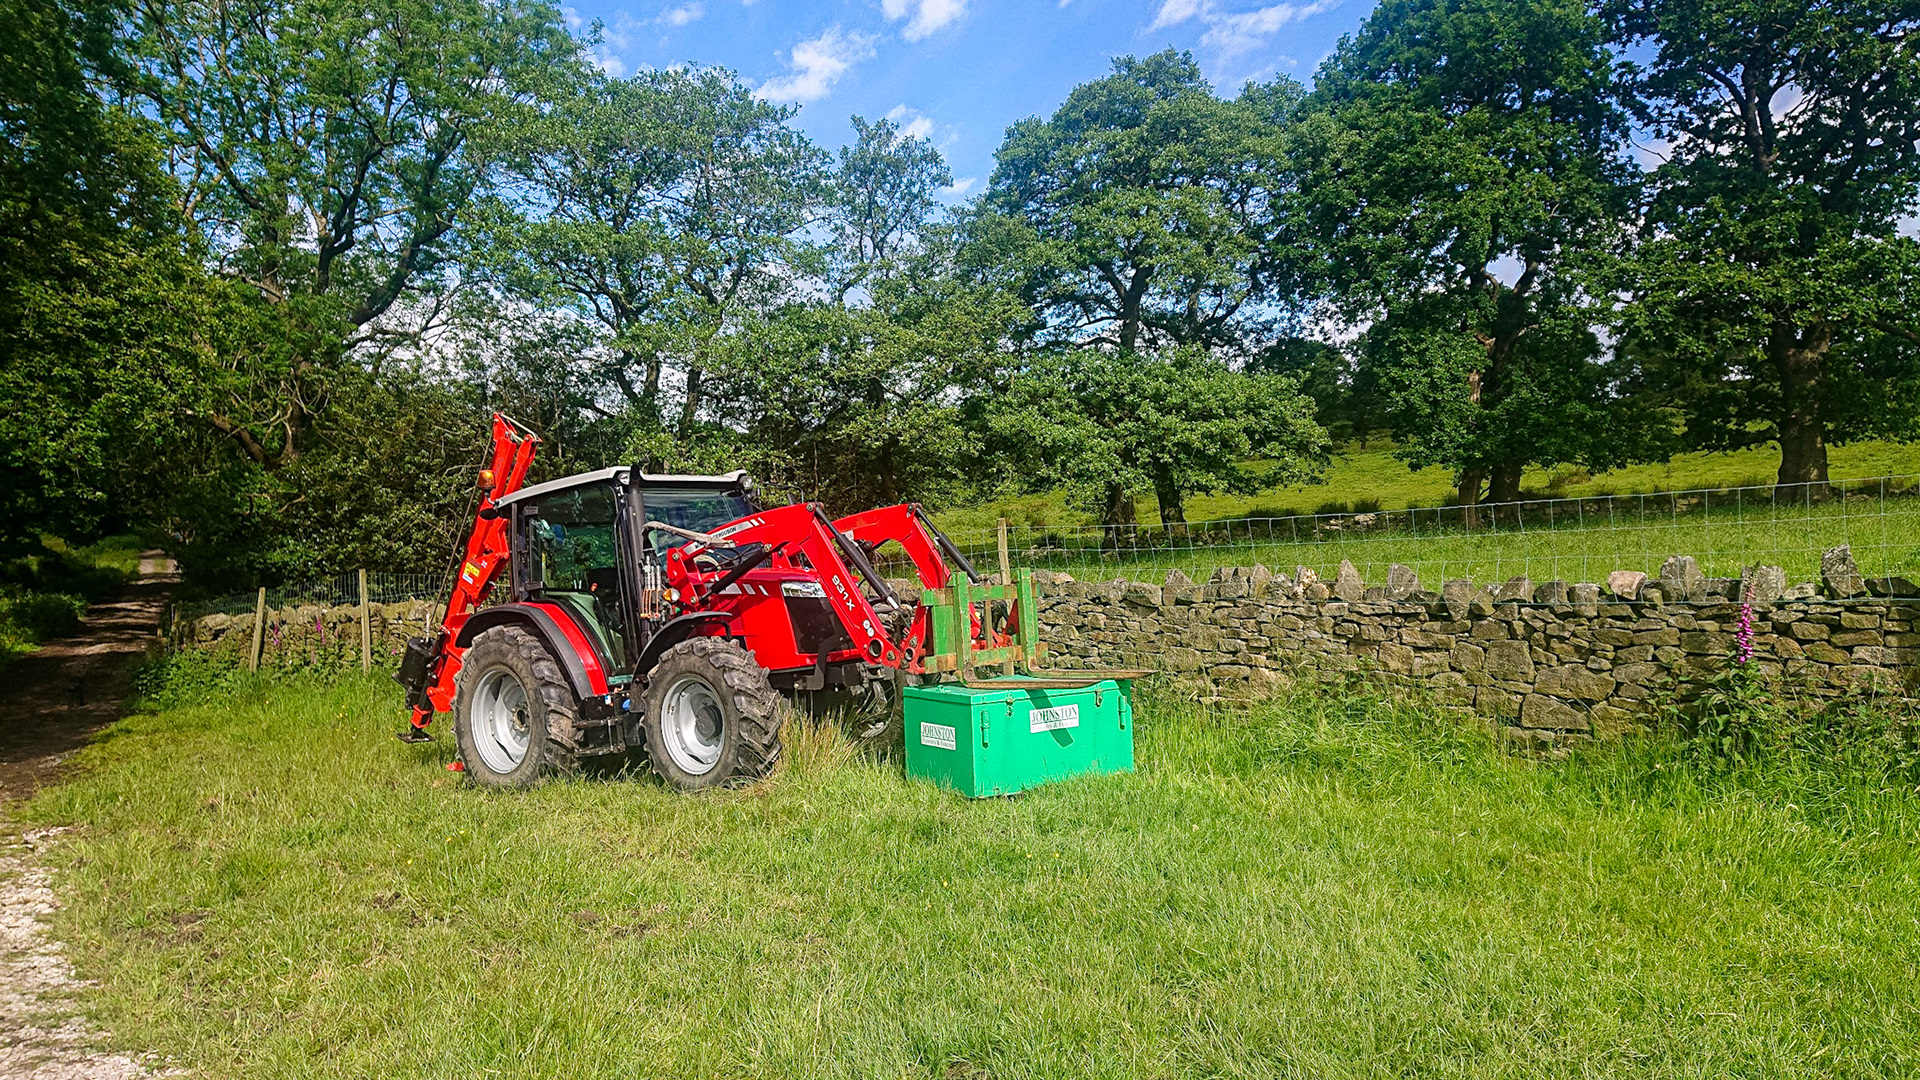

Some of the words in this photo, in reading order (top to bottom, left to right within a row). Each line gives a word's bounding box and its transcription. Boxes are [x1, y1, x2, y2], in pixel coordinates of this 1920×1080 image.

[831, 574, 855, 612] 931X
[1032, 706, 1078, 723] JOHNSTON
[922, 723, 955, 740] JOHNSTON
